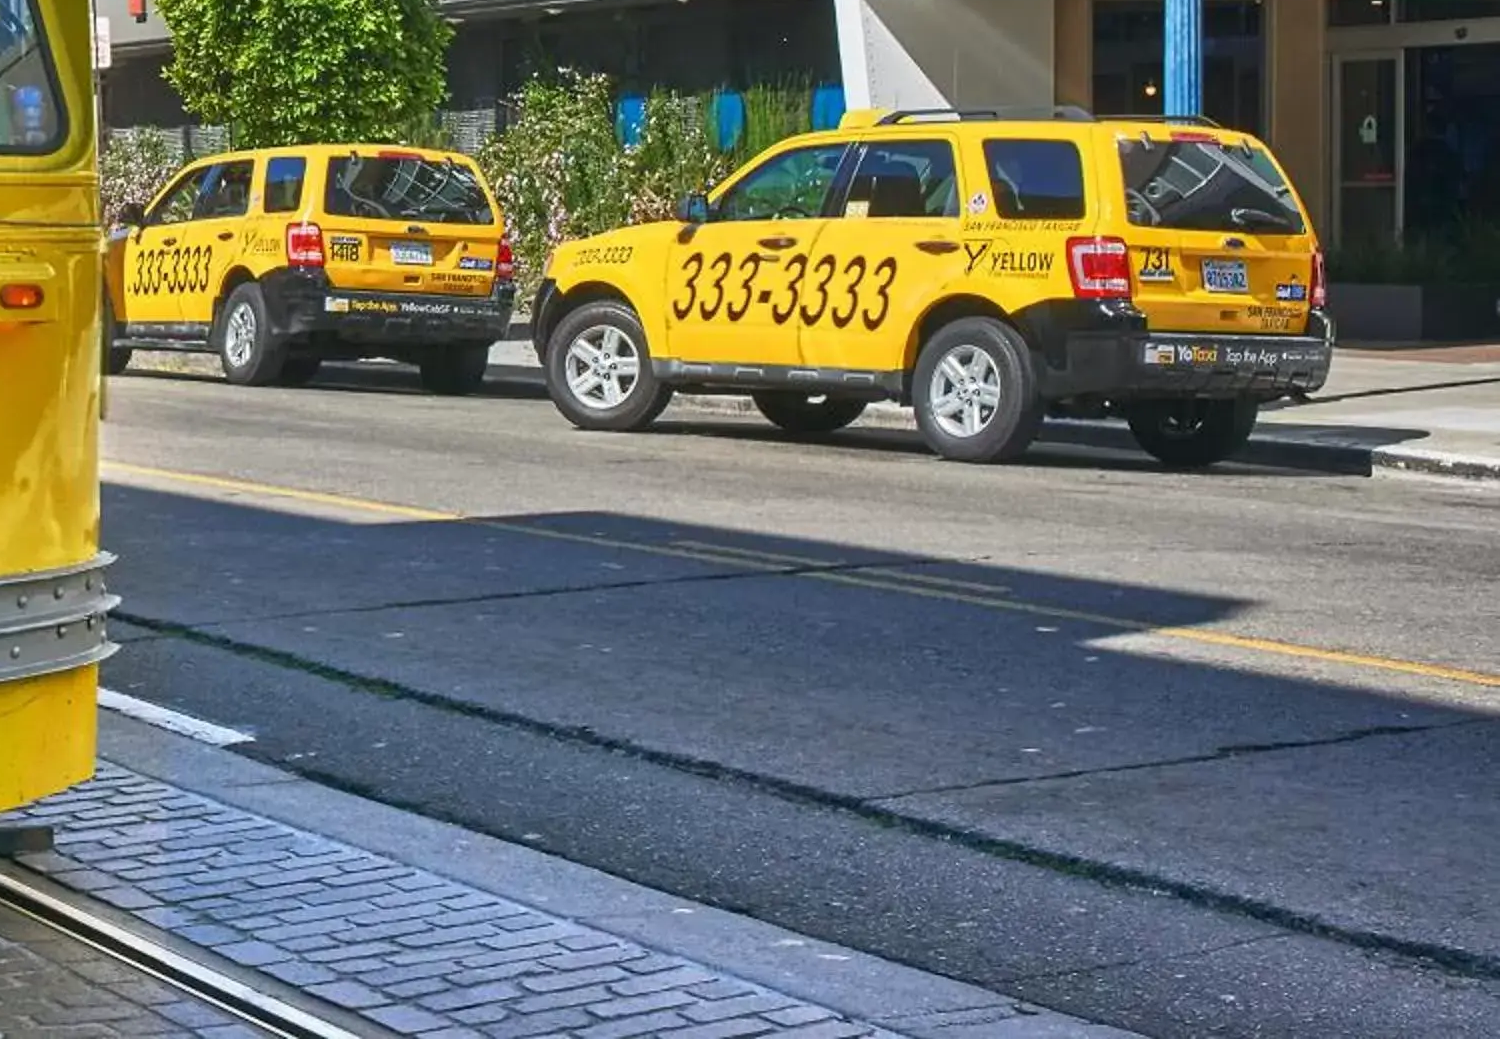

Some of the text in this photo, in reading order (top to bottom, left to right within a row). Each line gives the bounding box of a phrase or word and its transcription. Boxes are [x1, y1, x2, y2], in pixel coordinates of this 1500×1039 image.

[133, 245, 212, 296] 333-3333
[991, 252, 1055, 272] YELLOW
[1140, 247, 1171, 271] 731
[672, 251, 898, 332] 333-3333
[1177, 344, 1219, 363] YoTaxi
